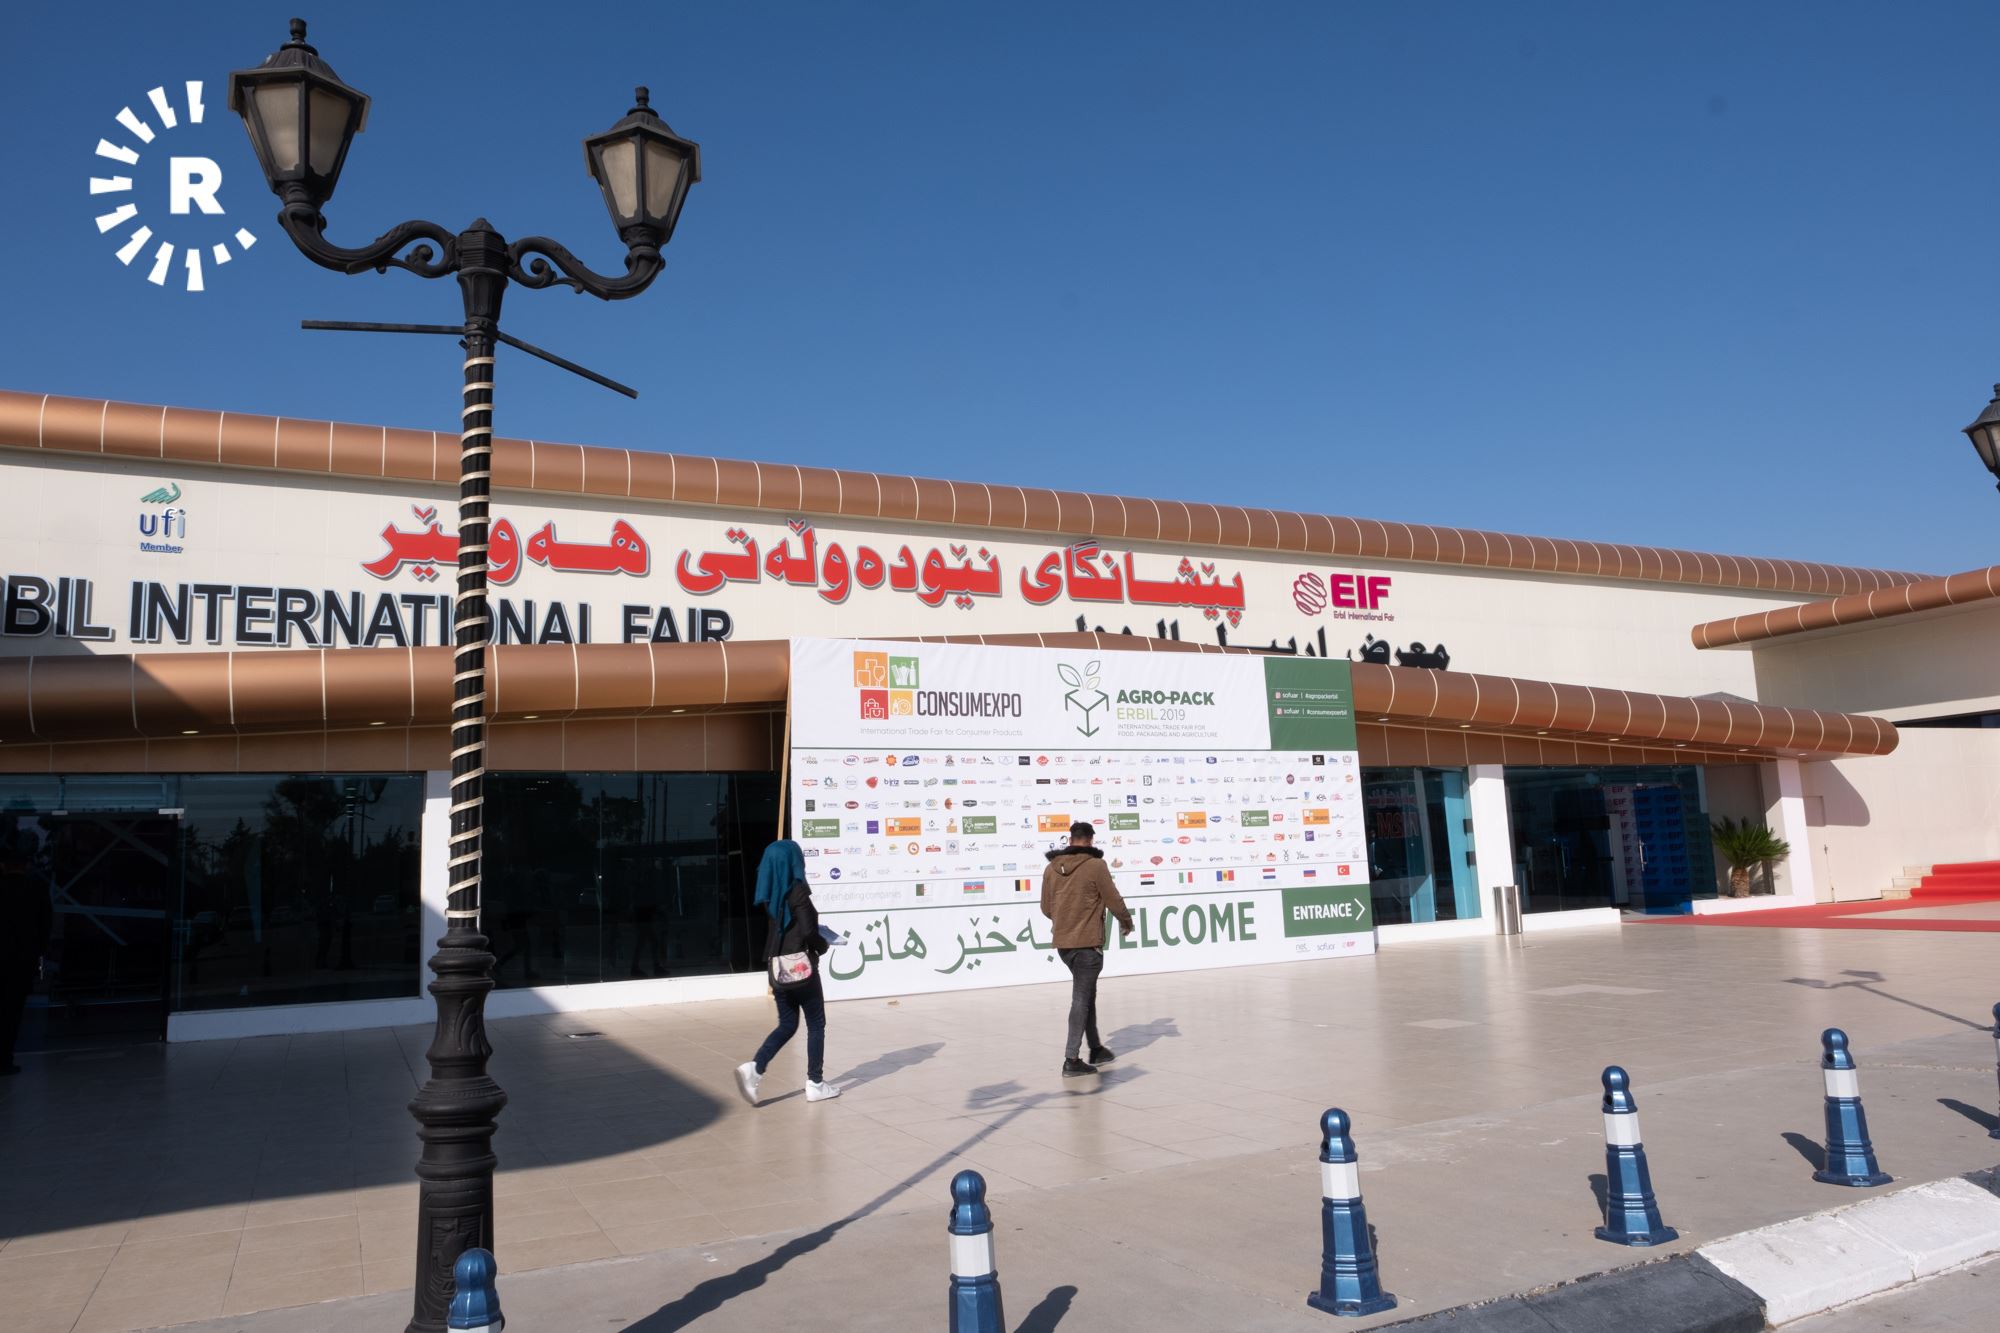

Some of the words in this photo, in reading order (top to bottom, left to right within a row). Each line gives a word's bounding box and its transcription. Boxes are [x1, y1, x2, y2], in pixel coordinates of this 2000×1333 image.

[139, 508, 185, 539] ufi
[140, 542, 184, 554] Member
[1330, 573, 1391, 610] EIF
[128, 578, 592, 648] INTERNATINAL
[621, 602, 734, 644] FAIR
[1333, 610, 1346, 620] Erbil
[1348, 611, 1384, 622] International
[1384, 613, 1395, 622] Fair
[917, 690, 1022, 718] CONSUMEXPO
[1116, 689, 1215, 706] AGRO-PACK
[1117, 707, 1158, 721] ERBIL
[1159, 708, 1186, 721] 2019
[860, 727, 907, 736] International
[908, 727, 929, 736] Trade
[930, 727, 943, 736] Fair
[945, 728, 954, 736] for
[956, 728, 991, 737] Consumer
[993, 728, 1023, 737] Products
[1292, 902, 1353, 921] ENTRANCE
[828, 913, 928, 981] هاتن
